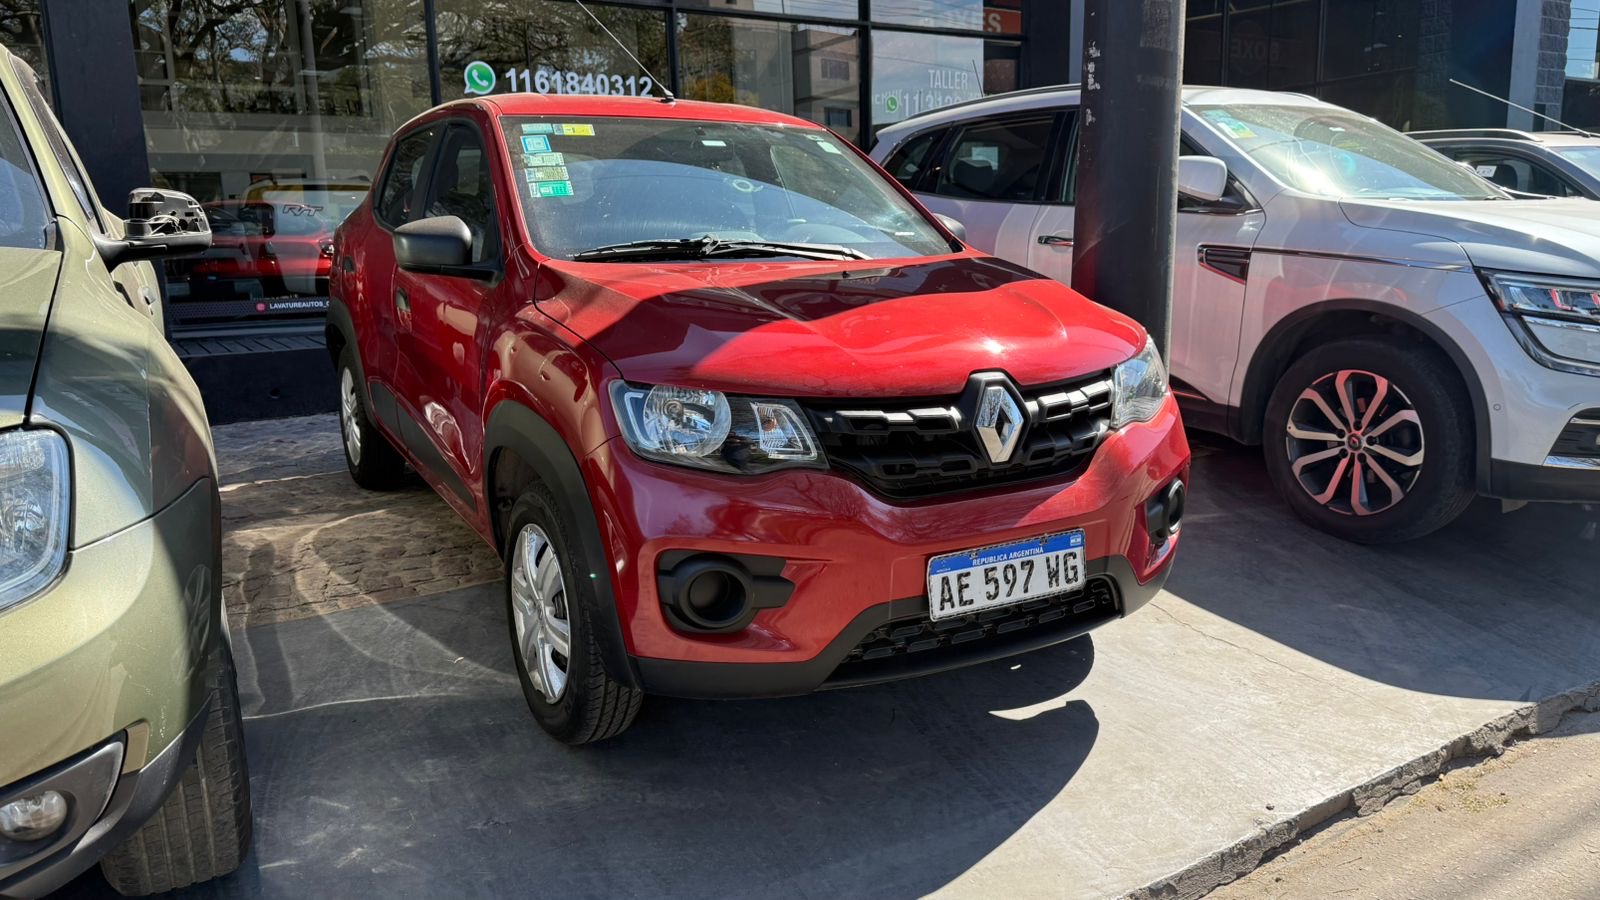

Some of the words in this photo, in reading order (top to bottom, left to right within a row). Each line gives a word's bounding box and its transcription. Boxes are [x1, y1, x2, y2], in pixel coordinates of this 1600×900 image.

[505, 68, 653, 97] 1161840312
[928, 69, 968, 90] TALLER
[972, 554, 1008, 567] REPUBLICA
[1009, 546, 1044, 560] ARGENTINA
[939, 571, 974, 611] AE
[984, 559, 1035, 601] 597
[1045, 551, 1079, 588] WG
